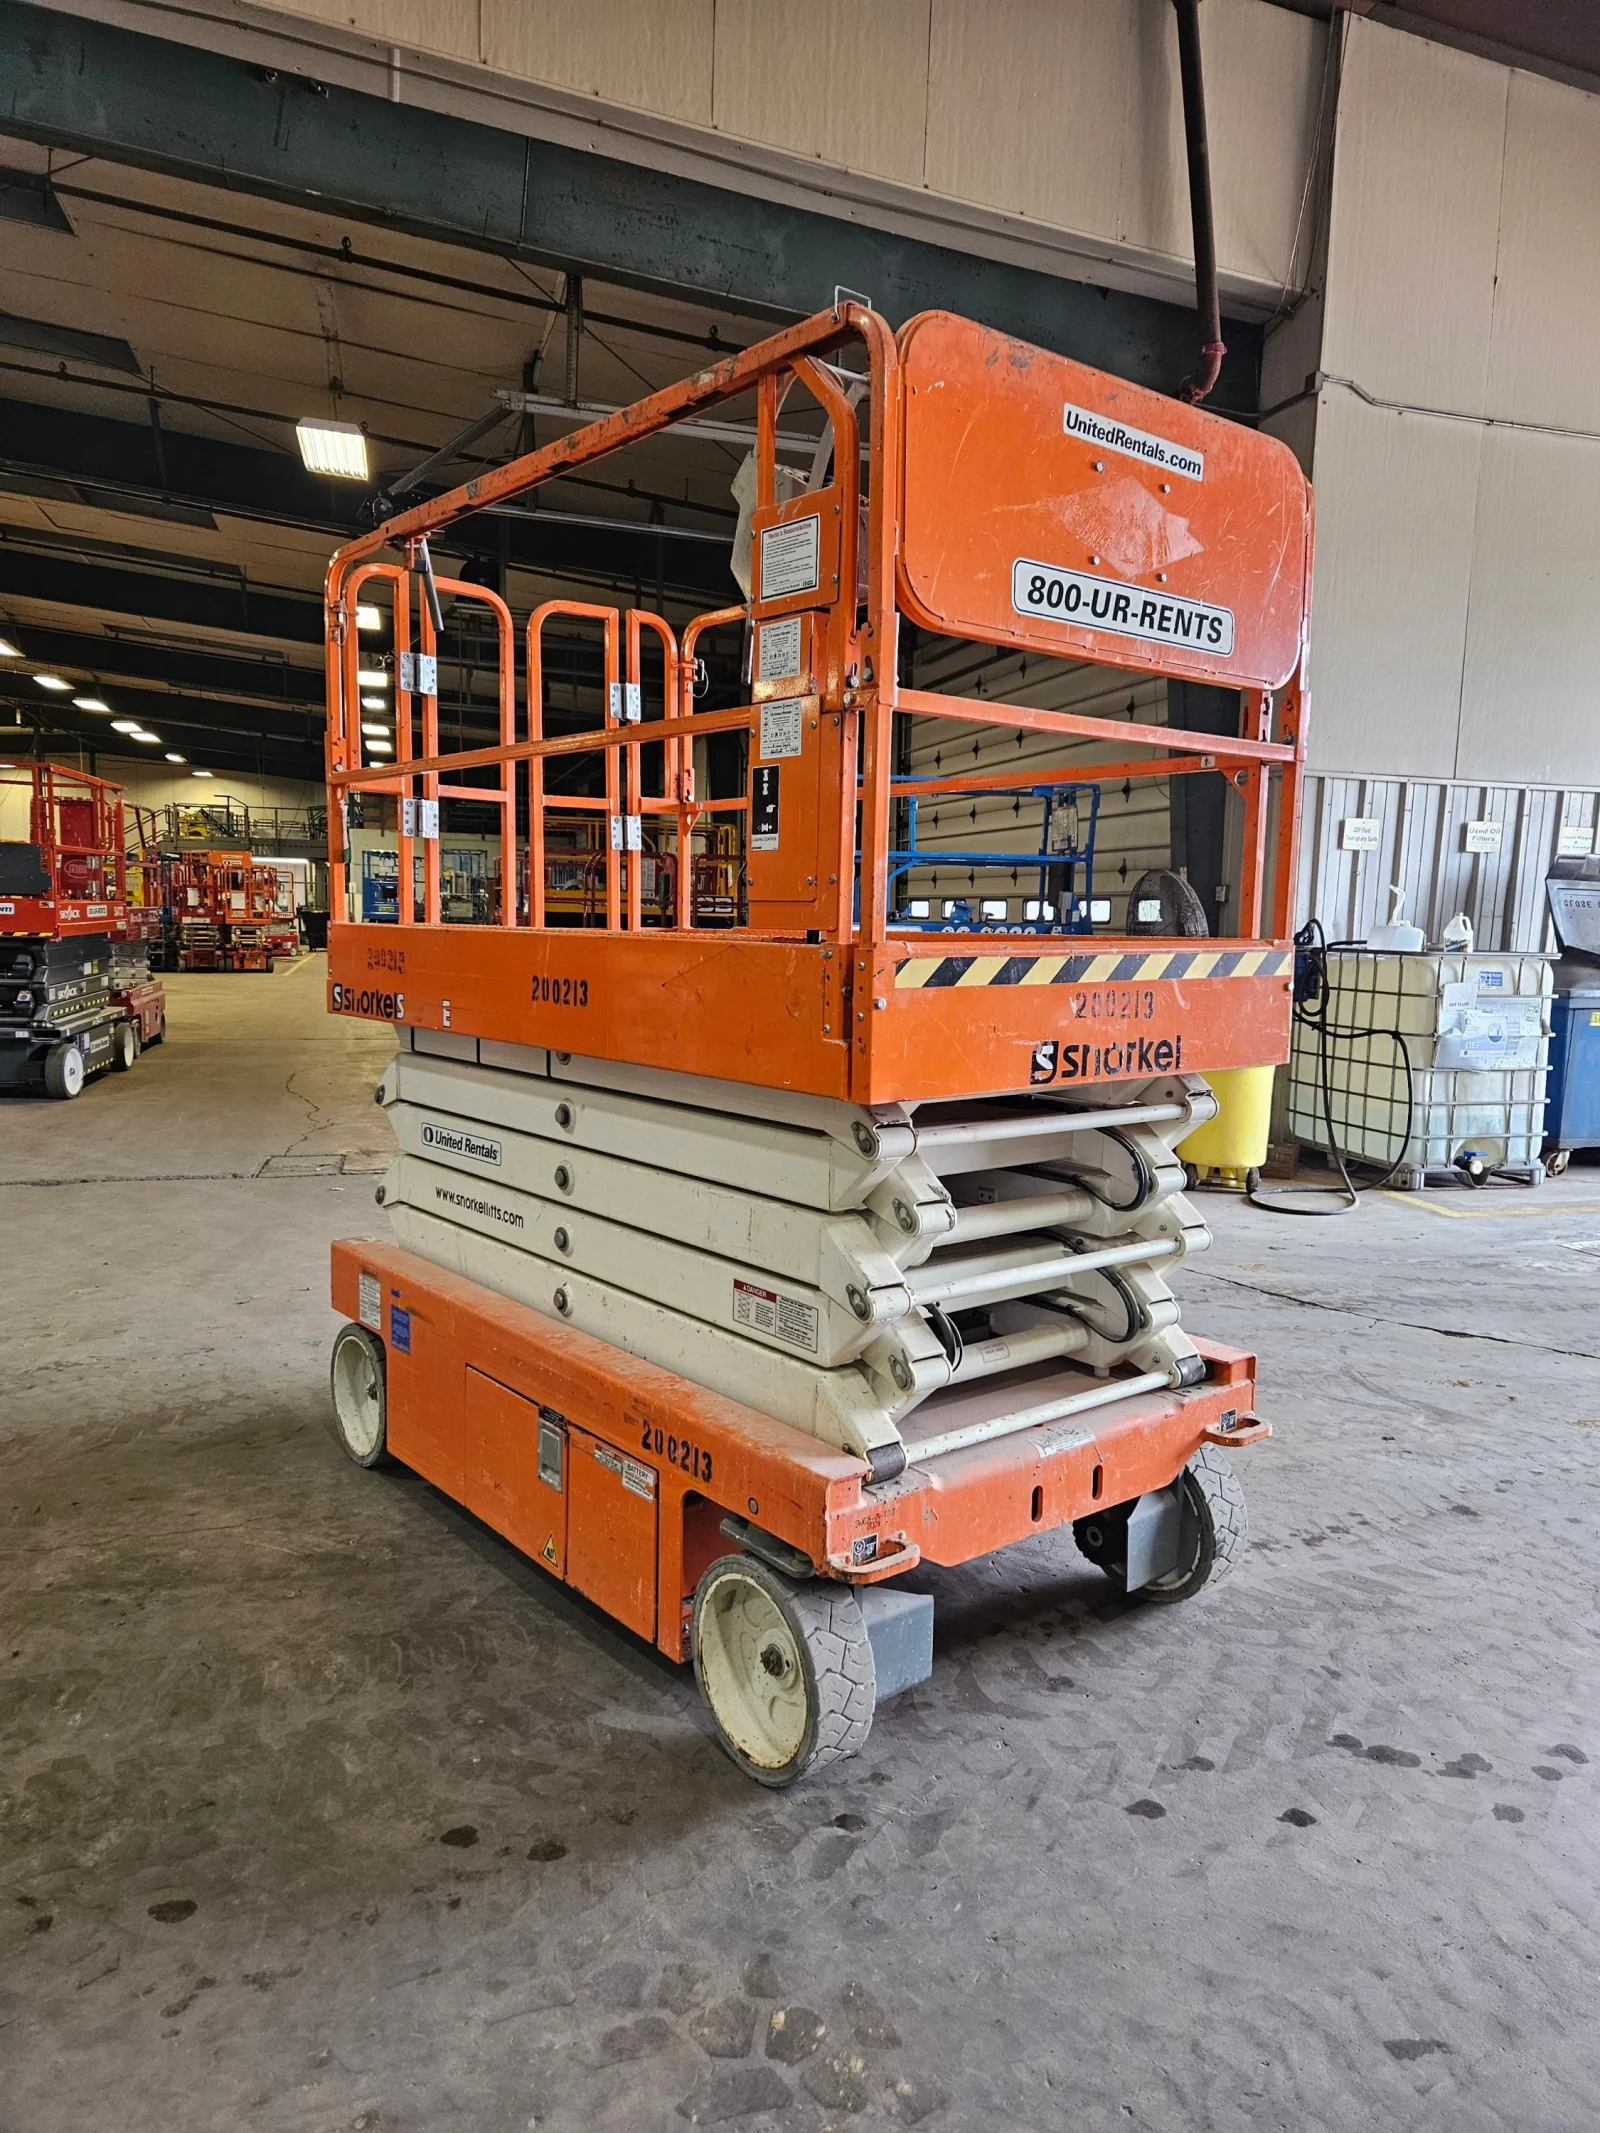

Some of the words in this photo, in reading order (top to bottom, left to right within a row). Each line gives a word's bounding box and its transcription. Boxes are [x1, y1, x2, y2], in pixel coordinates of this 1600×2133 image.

[1066, 411, 1201, 475] UnitedRentals.com
[1028, 575, 1223, 644] 800-UR-RENTS
[532, 975, 589, 1007] 200213
[1075, 989, 1156, 1019] 200213
[1061, 1035, 1181, 1079] snorkel
[435, 1130, 462, 1151] United
[465, 1137, 498, 1160] Rentals
[746, 1285, 767, 1298] DANGER
[642, 1419, 712, 1483] 200213
[627, 1463, 648, 1480] BATTERY
